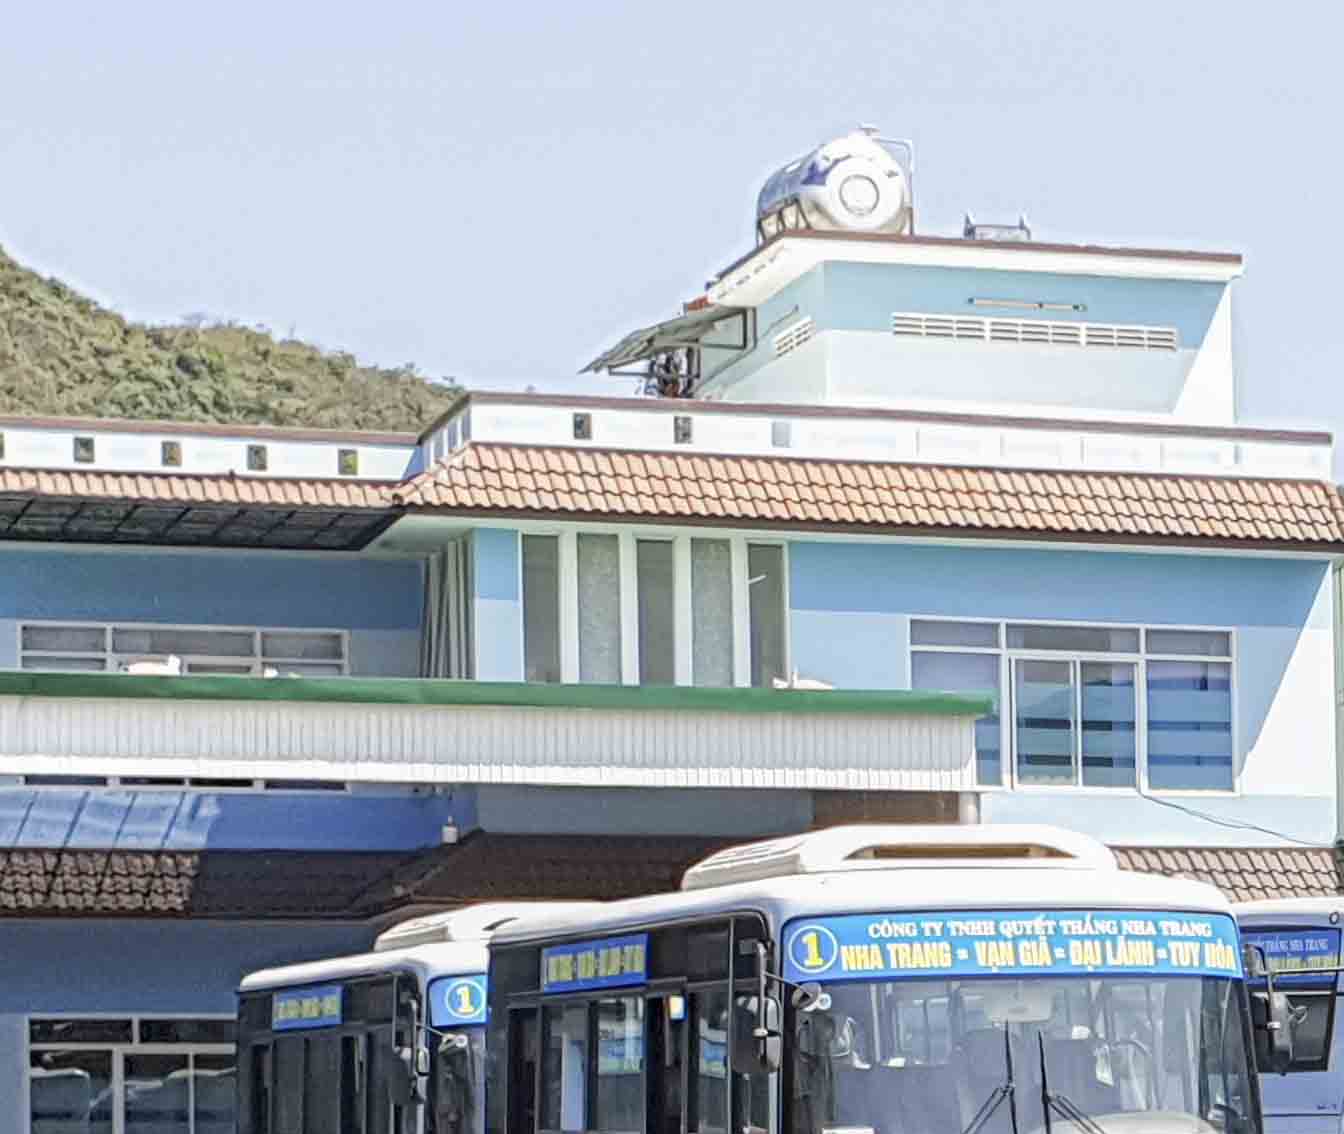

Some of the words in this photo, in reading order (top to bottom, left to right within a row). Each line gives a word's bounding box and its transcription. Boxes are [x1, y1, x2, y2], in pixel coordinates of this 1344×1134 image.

[868, 916, 917, 938] CÔNG
[920, 920, 944, 937] TY
[947, 919, 995, 937] TNHH
[1122, 919, 1156, 936] NHA
[1160, 920, 1212, 937] TRANG
[802, 932, 824, 967] 1
[840, 945, 885, 972] NHA
[887, 941, 954, 970] TRANG
[974, 941, 1016, 974] VẠN
[1168, 940, 1202, 968] TUY
[456, 986, 472, 1014] 1
